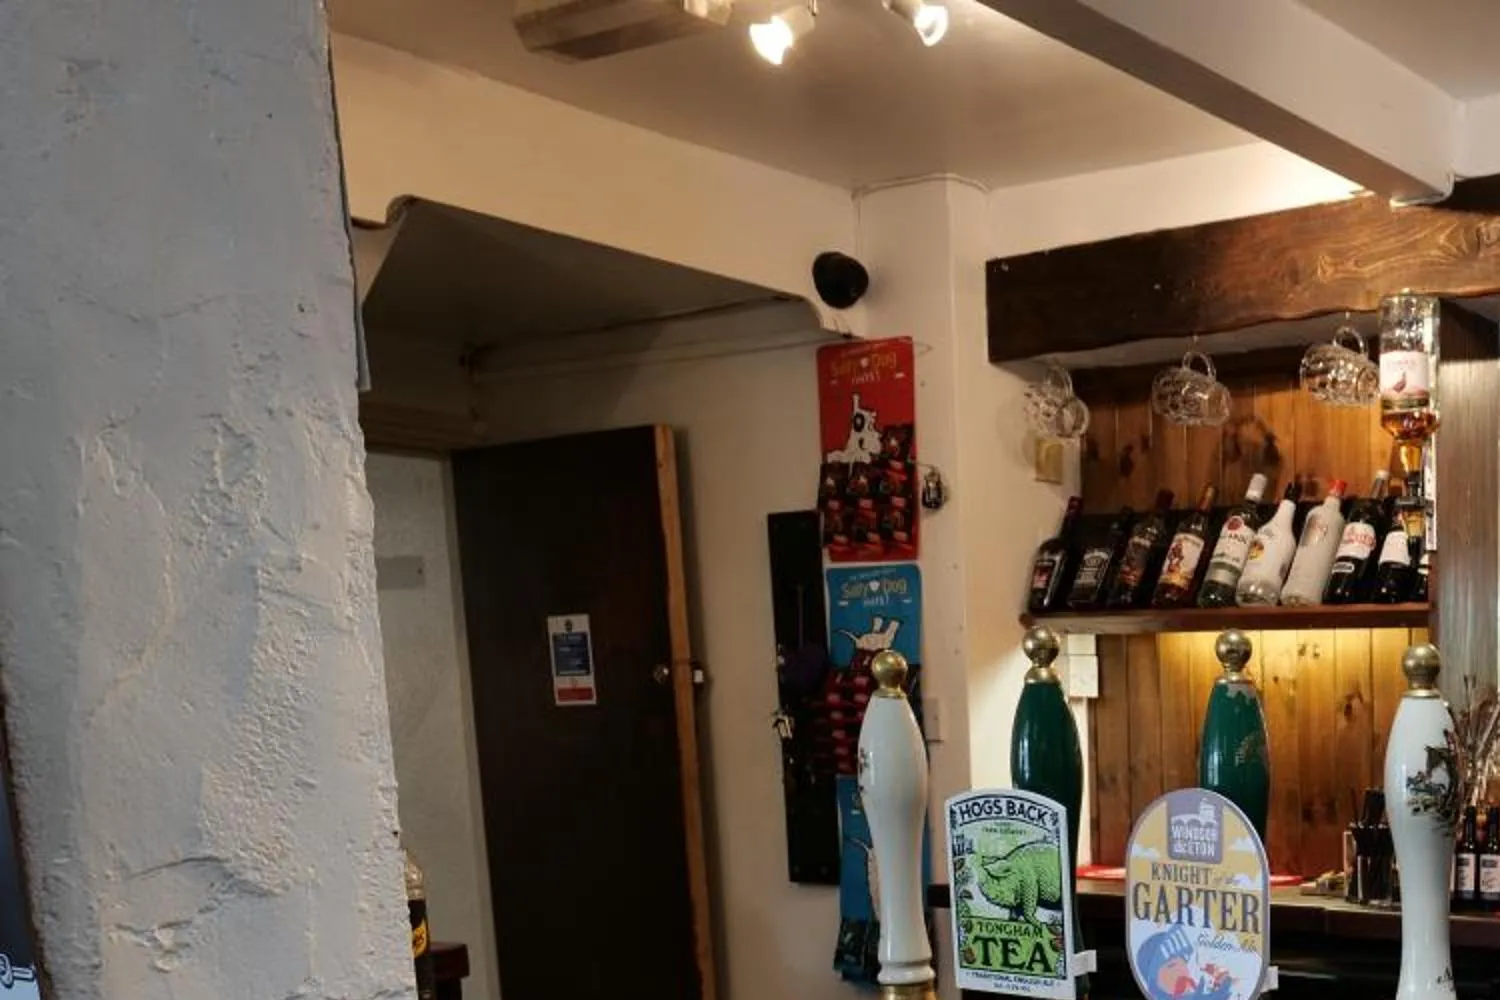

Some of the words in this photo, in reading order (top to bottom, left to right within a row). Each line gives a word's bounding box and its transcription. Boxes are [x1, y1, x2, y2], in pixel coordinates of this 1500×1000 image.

[960, 799, 1003, 821] HOGS
[1005, 800, 1048, 826] BACK
[1151, 862, 1211, 885] KNIGHT
[1133, 882, 1260, 934] GARTER
[976, 920, 1043, 938] TONGHAM
[972, 935, 1054, 974] TEA
